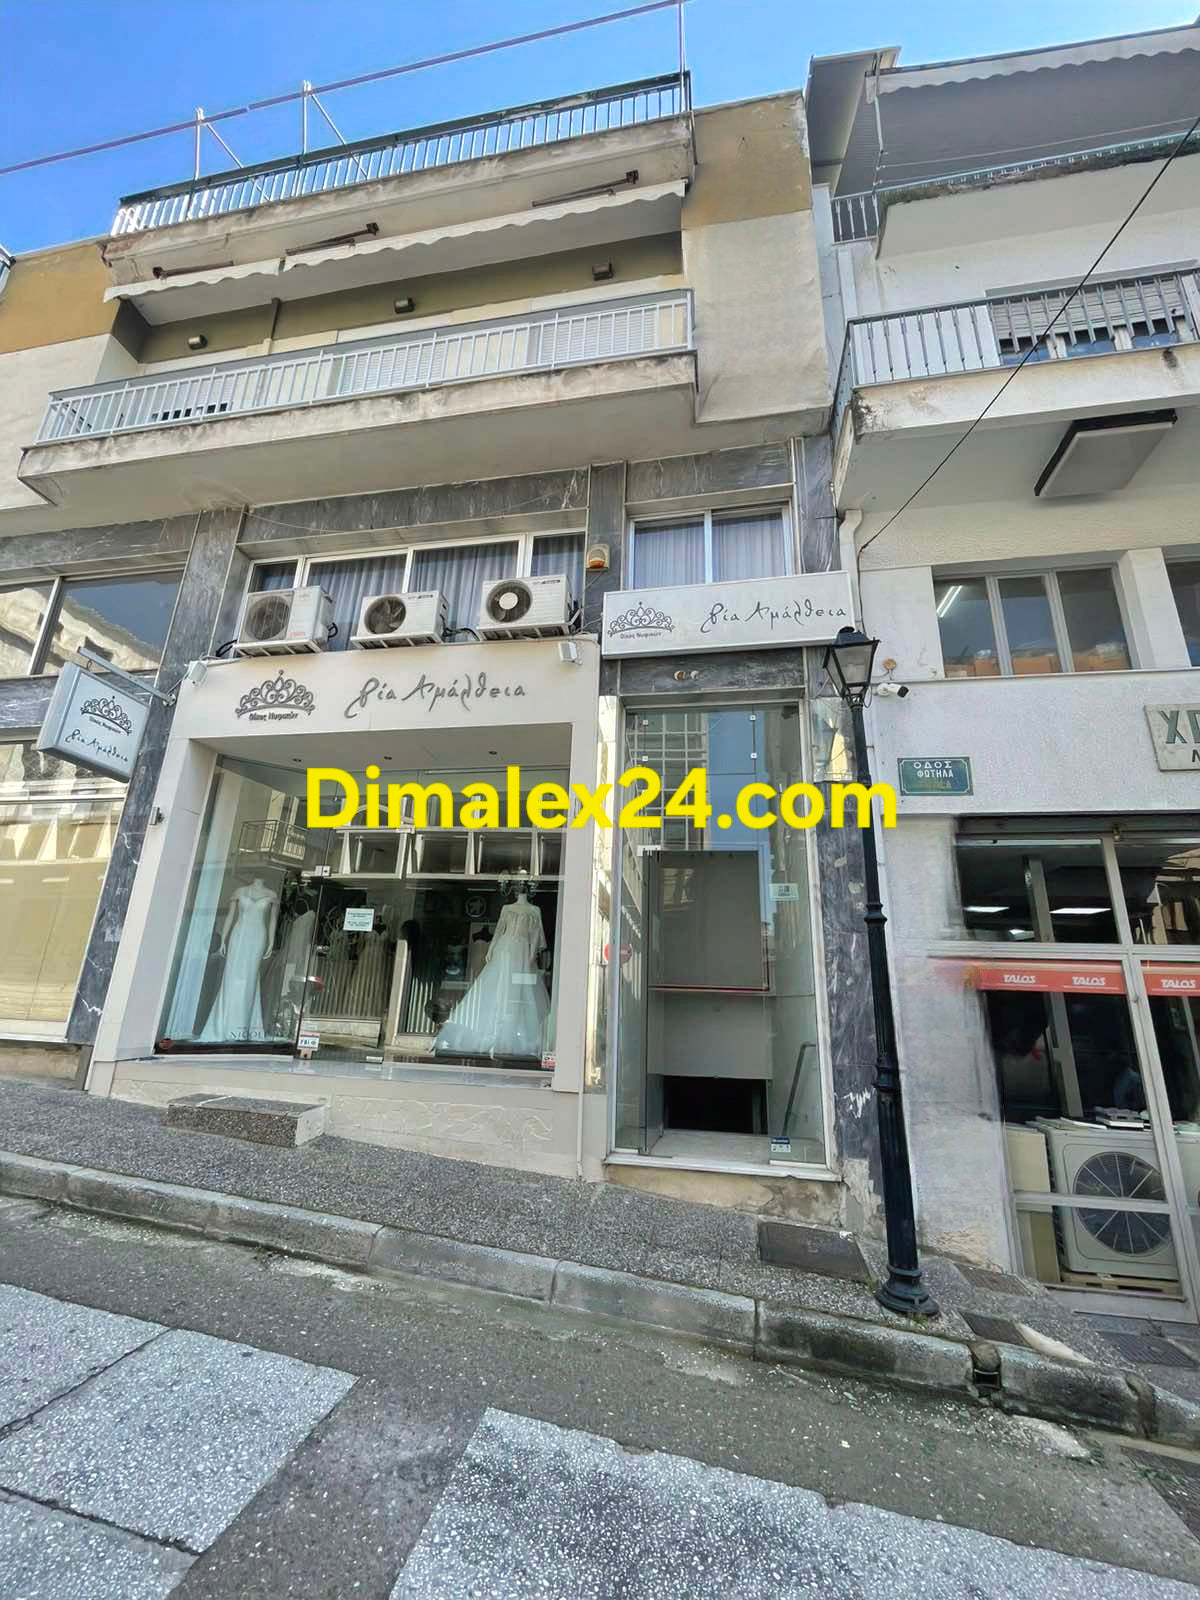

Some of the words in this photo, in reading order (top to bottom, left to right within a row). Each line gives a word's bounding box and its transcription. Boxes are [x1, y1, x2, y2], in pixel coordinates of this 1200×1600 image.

[913, 761, 953, 769] ΟΔΟΣ
[1003, 975, 1036, 985] TALOS
[1072, 976, 1106, 986] TALOS
[1160, 979, 1197, 989] TALOS
